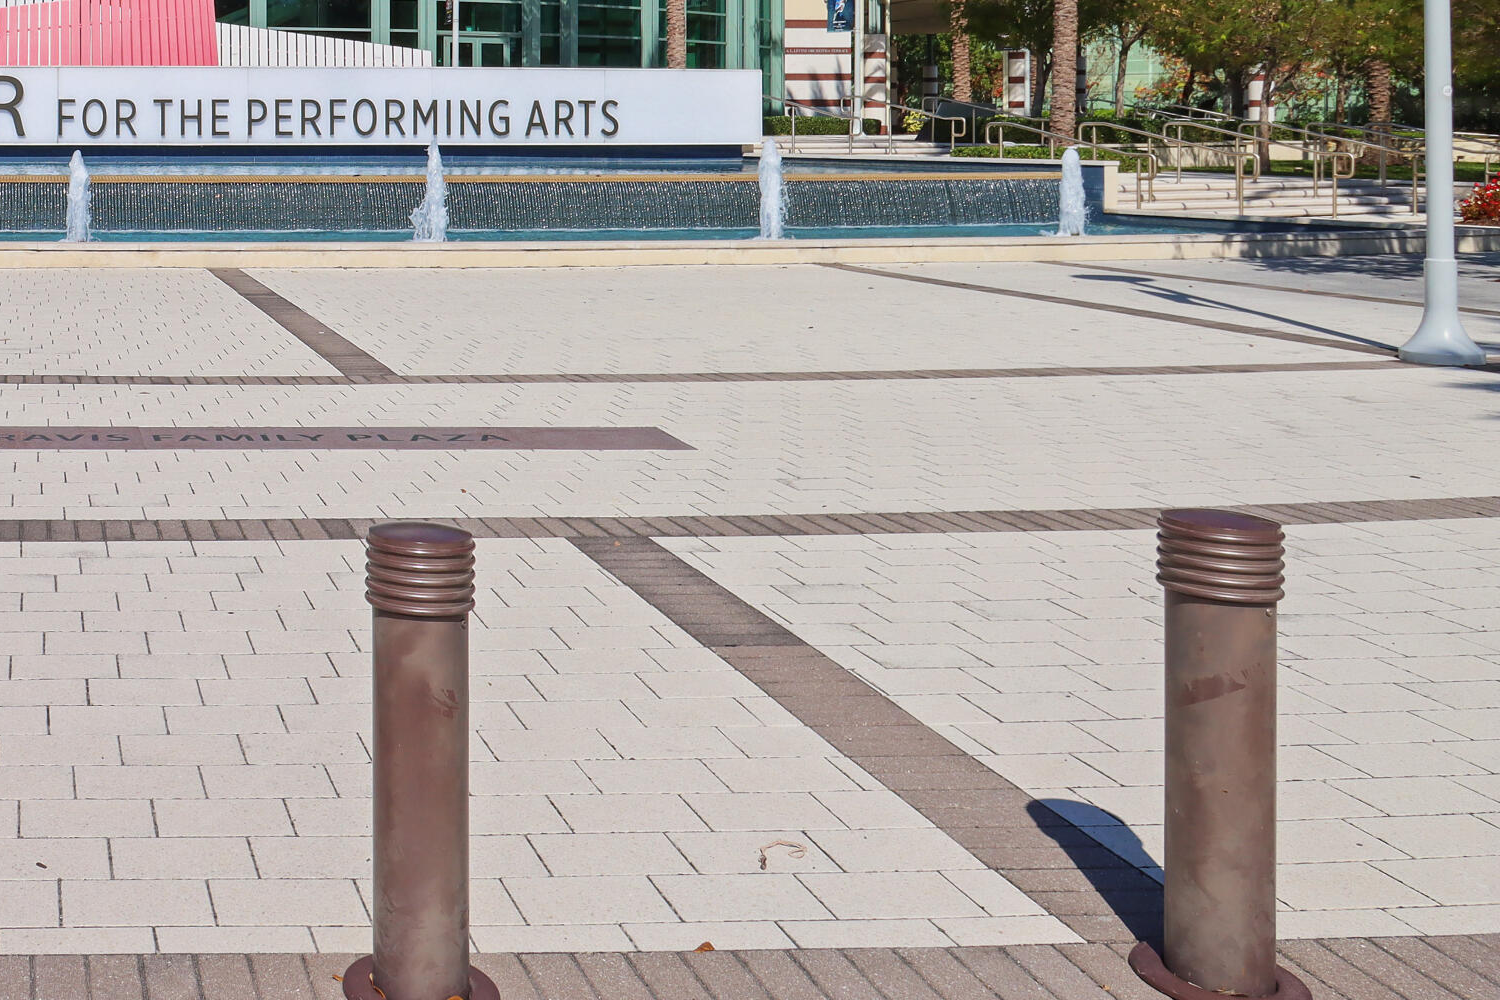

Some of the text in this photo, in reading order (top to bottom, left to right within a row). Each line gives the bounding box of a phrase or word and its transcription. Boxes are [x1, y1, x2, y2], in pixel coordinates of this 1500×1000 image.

[57, 98, 137, 137] FOR
[153, 98, 230, 137] THE
[246, 98, 510, 137] PERFORMING
[524, 99, 620, 137] ARTS
[151, 433, 324, 443] FAMILY
[346, 433, 511, 443] PLAZA
